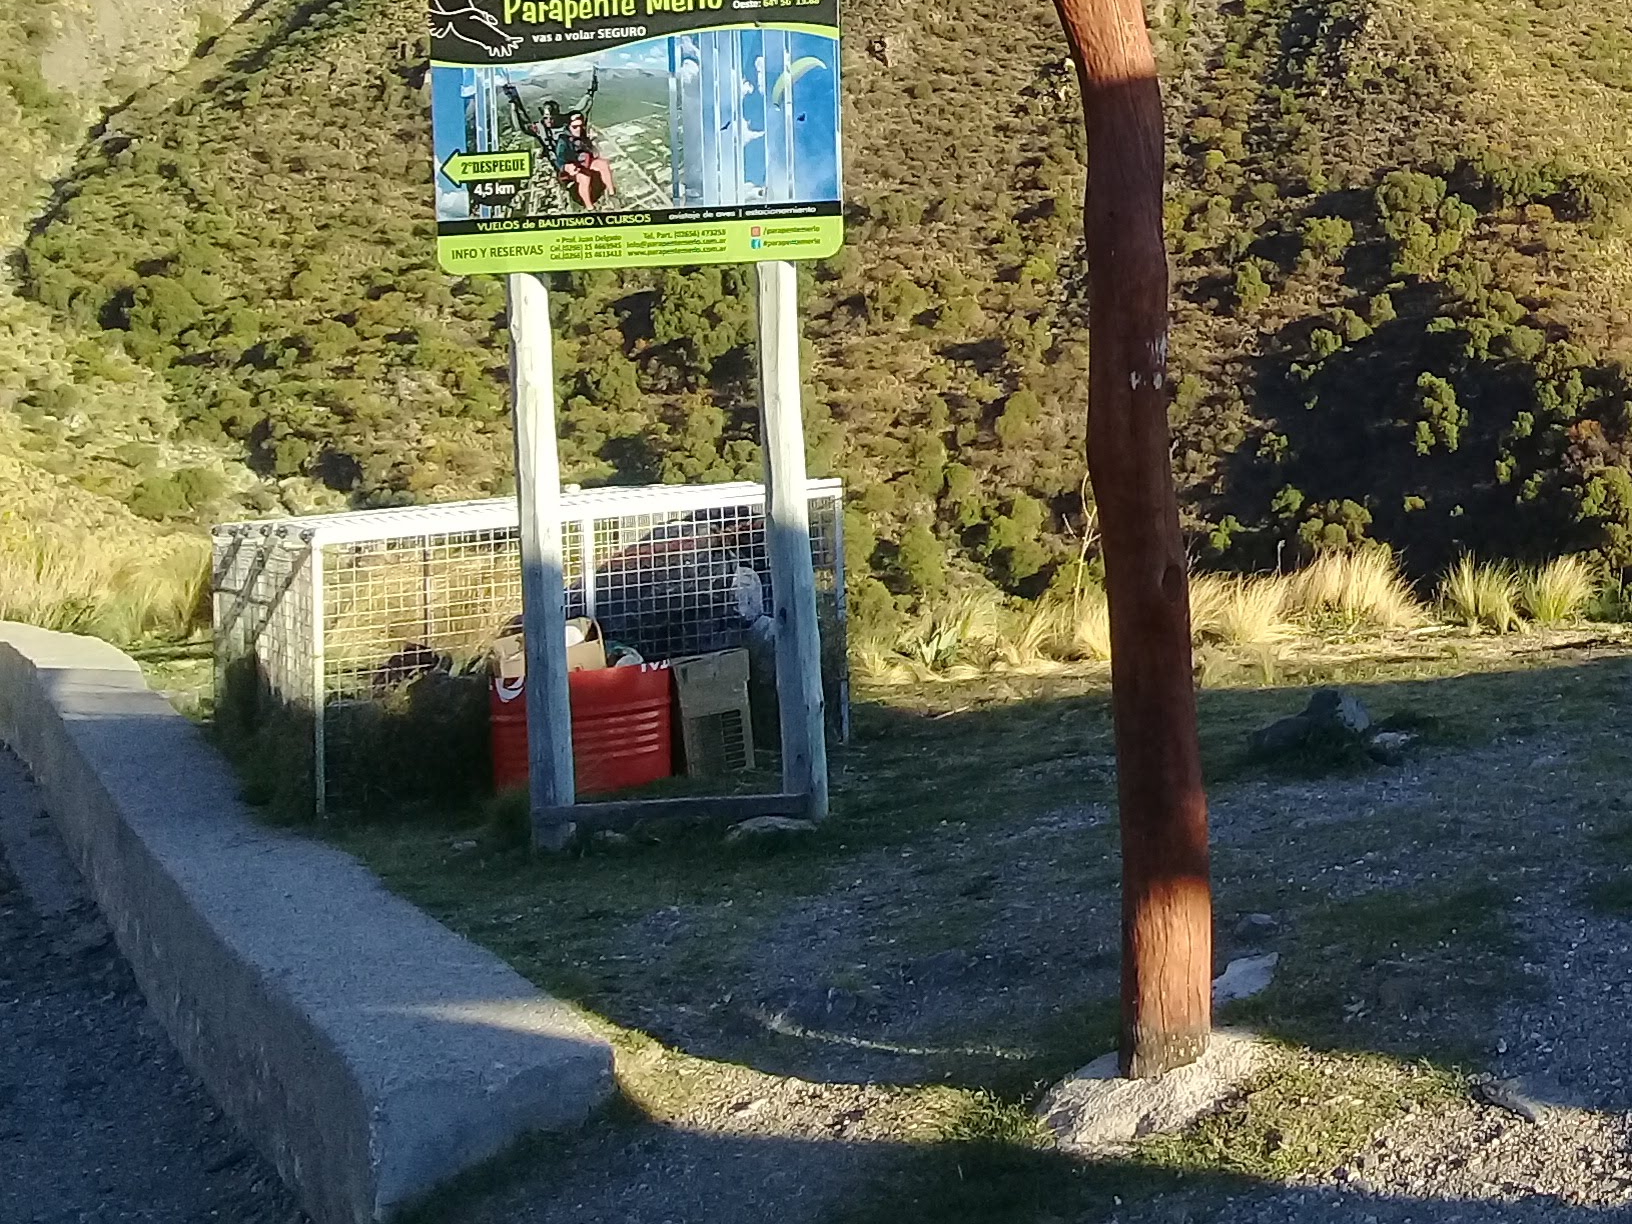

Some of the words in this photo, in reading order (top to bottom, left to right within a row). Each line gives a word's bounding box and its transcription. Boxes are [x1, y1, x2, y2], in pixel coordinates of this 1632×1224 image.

[732, 0, 761, 9] Oeste:
[532, 34, 552, 43] vas
[555, 34, 562, 42] a
[565, 31, 595, 41] volar
[597, 26, 647, 39] SEGURO
[474, 182, 494, 198] 4,5
[495, 182, 516, 195] km
[703, 210, 714, 218] de
[716, 210, 736, 218] aves
[745, 206, 816, 216] estacionamiento
[477, 220, 520, 232] VUELOS
[523, 220, 535, 229] de
[538, 216, 595, 228] BAUTISMO
[605, 213, 651, 224] CURSOS
[452, 249, 478, 260] INFO
[480, 248, 488, 258] Y
[493, 245, 544, 258] RESERVAS
